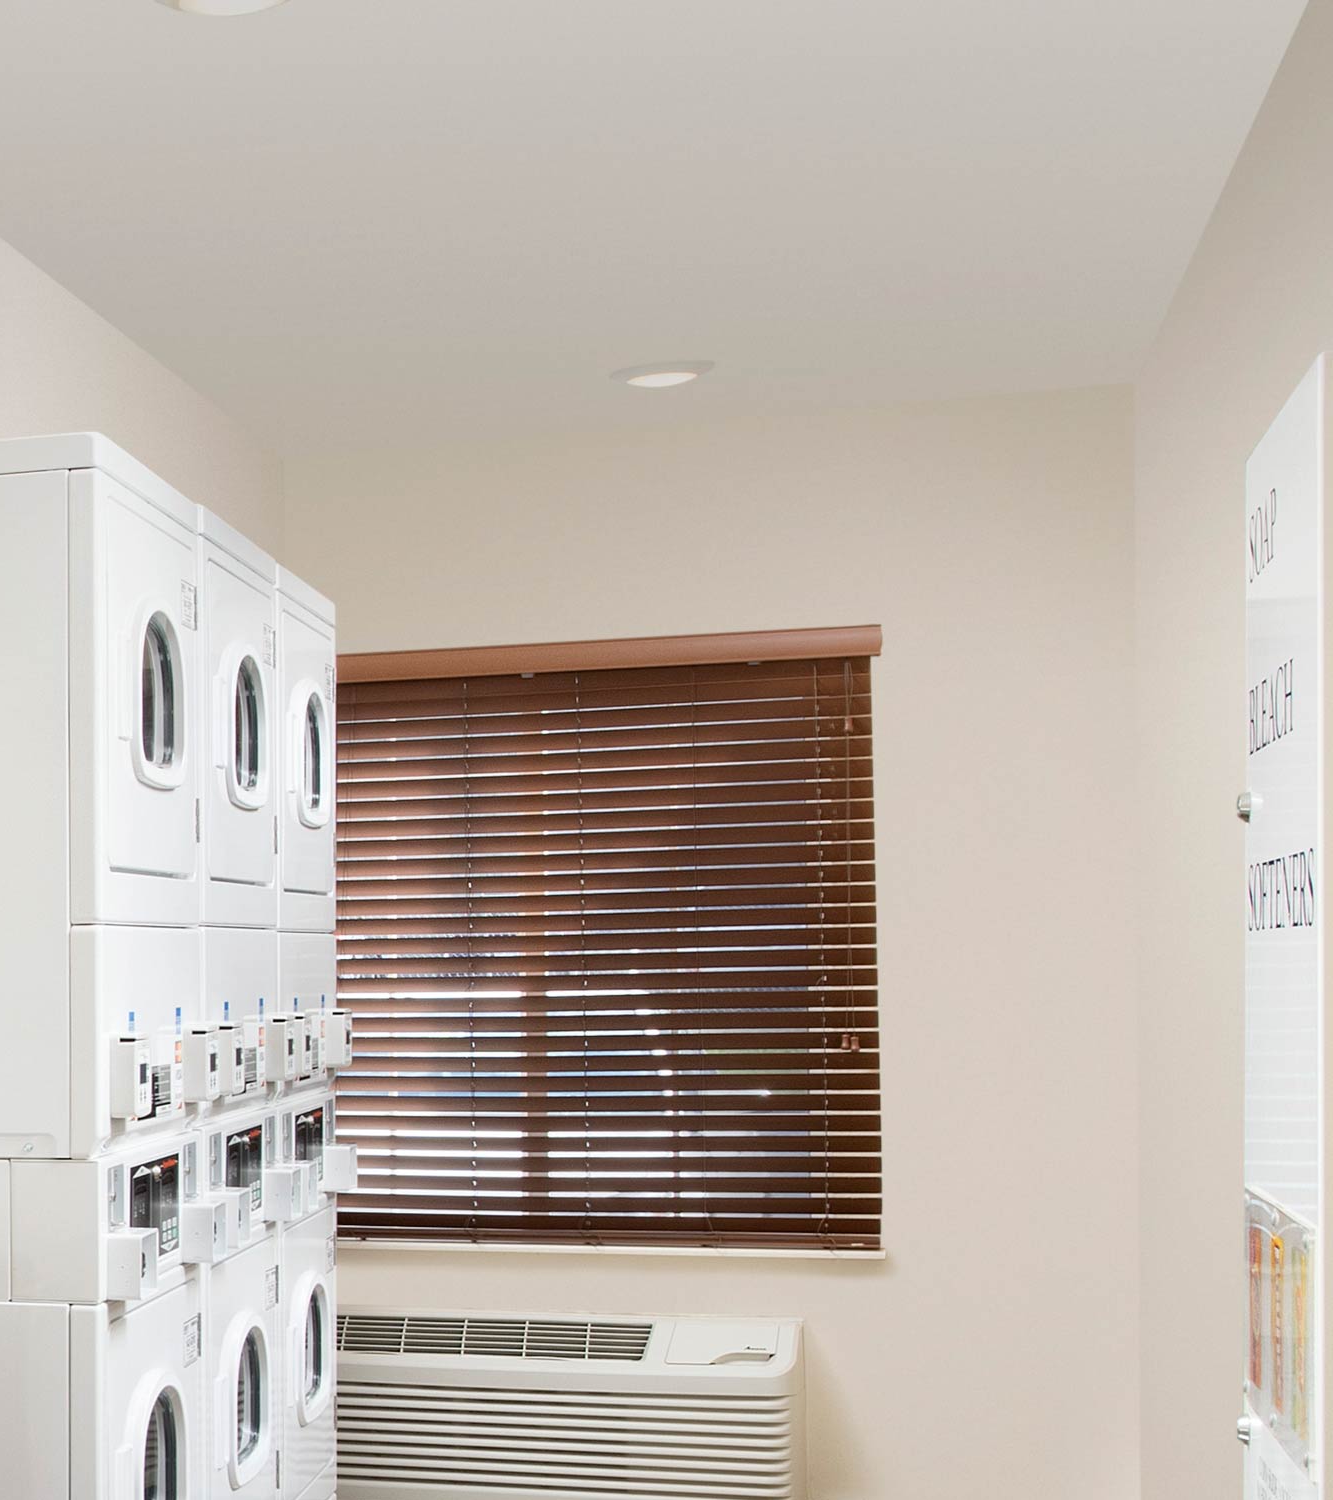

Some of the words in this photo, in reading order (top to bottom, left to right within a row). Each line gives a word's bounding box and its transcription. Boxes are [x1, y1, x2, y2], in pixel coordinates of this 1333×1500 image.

[1249, 488, 1277, 583] SOAP
[1248, 658, 1294, 755] BLEACH
[1248, 848, 1315, 932] SOFTENERS
